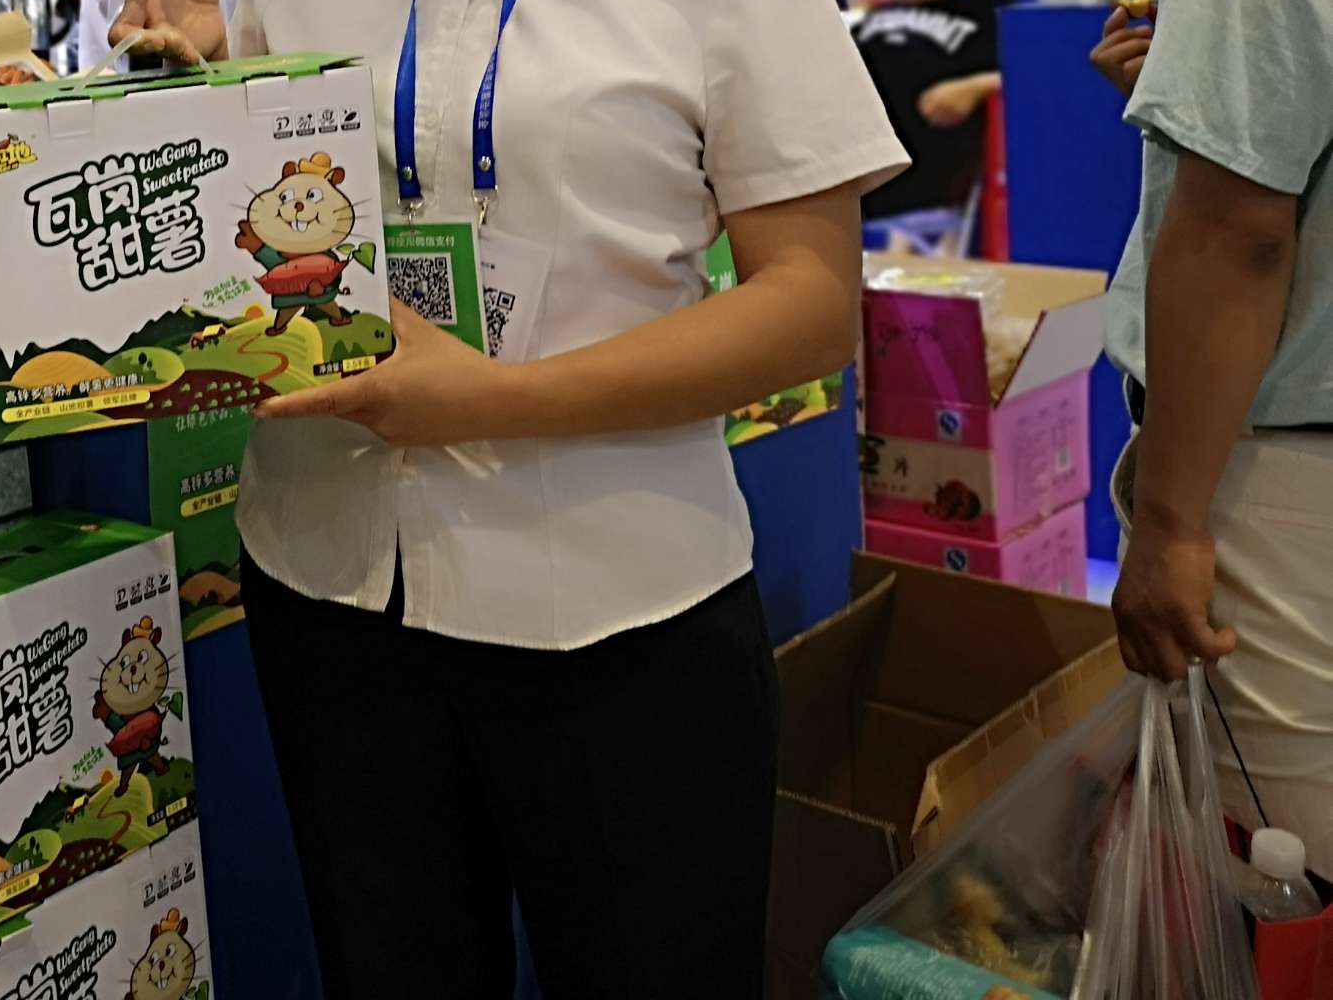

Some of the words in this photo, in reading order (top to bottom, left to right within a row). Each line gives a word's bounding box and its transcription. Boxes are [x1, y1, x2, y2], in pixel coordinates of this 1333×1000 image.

[27, 155, 141, 244] 瓦岗
[138, 140, 198, 174] WaGang
[76, 187, 203, 288] 甜薯
